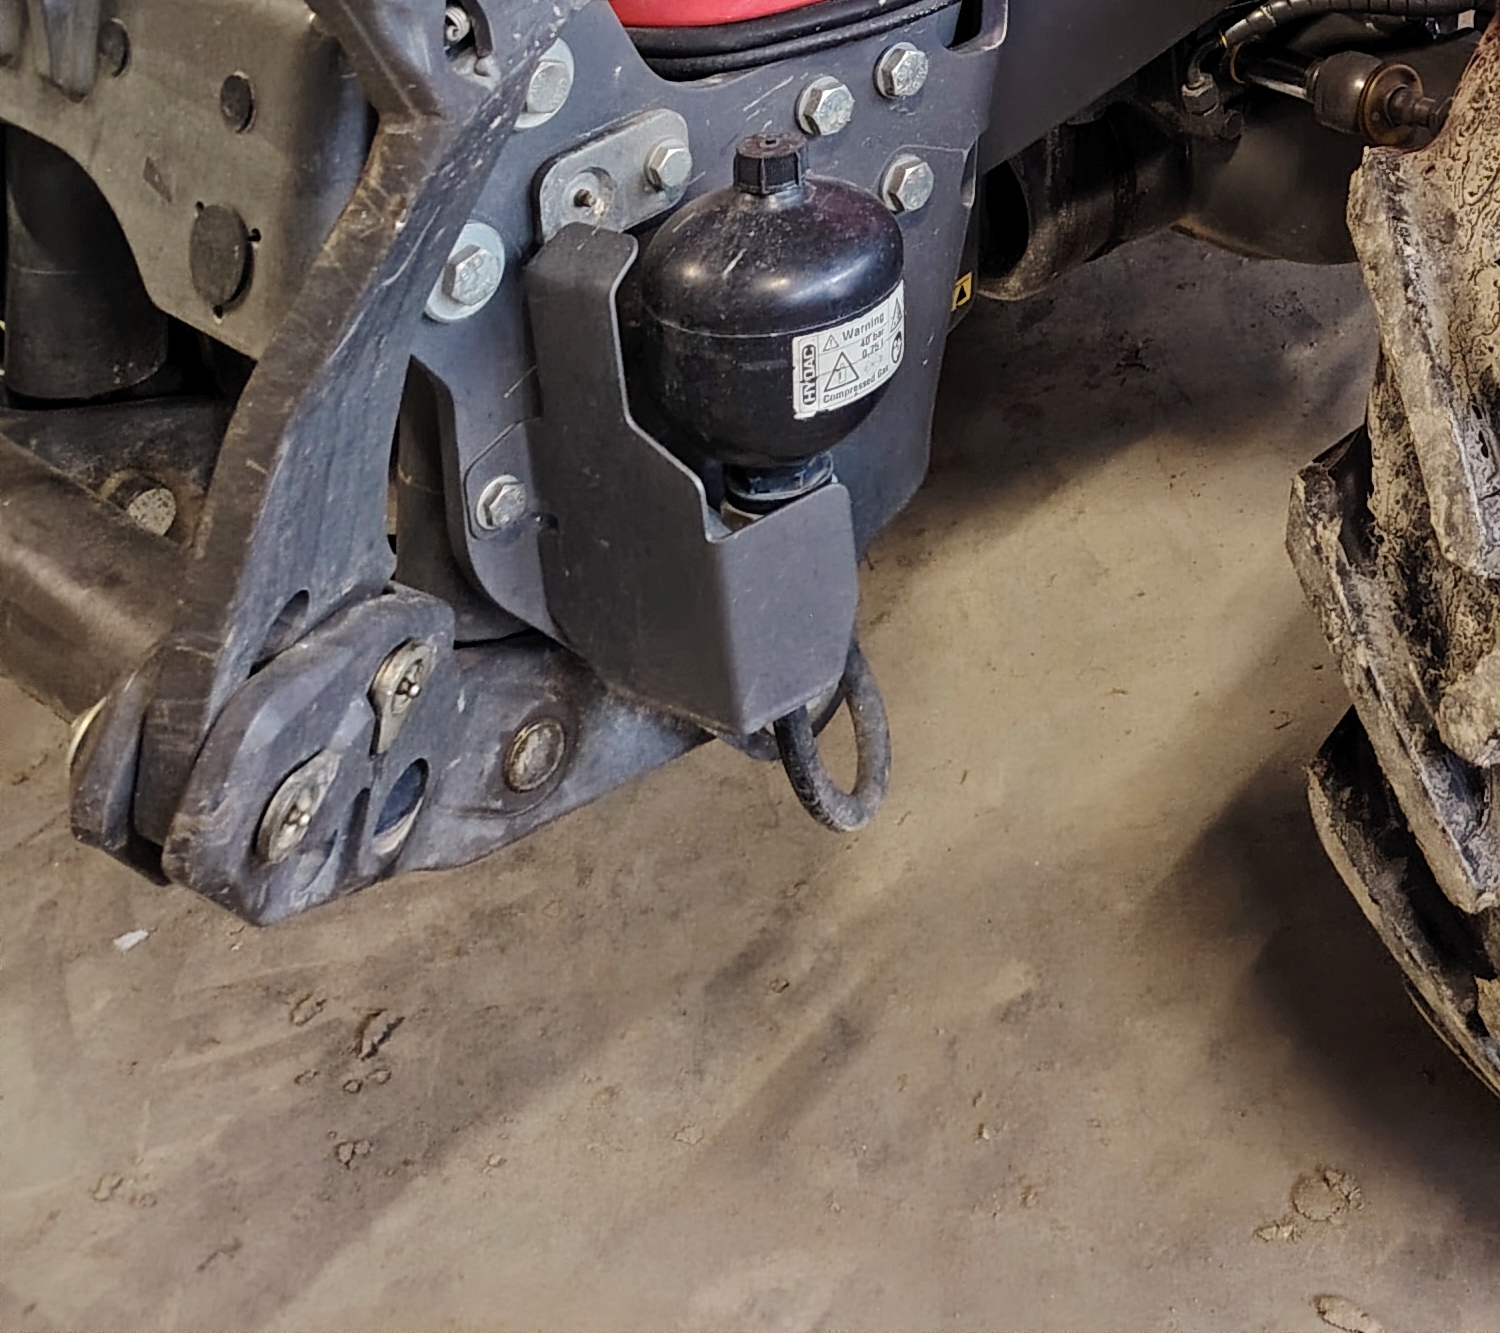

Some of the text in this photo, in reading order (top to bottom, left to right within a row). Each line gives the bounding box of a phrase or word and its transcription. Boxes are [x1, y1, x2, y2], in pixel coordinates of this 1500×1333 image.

[842, 312, 885, 342] Warning
[873, 328, 885, 342] bar
[801, 344, 816, 405] HYDAC
[823, 372, 876, 404] Compressed
